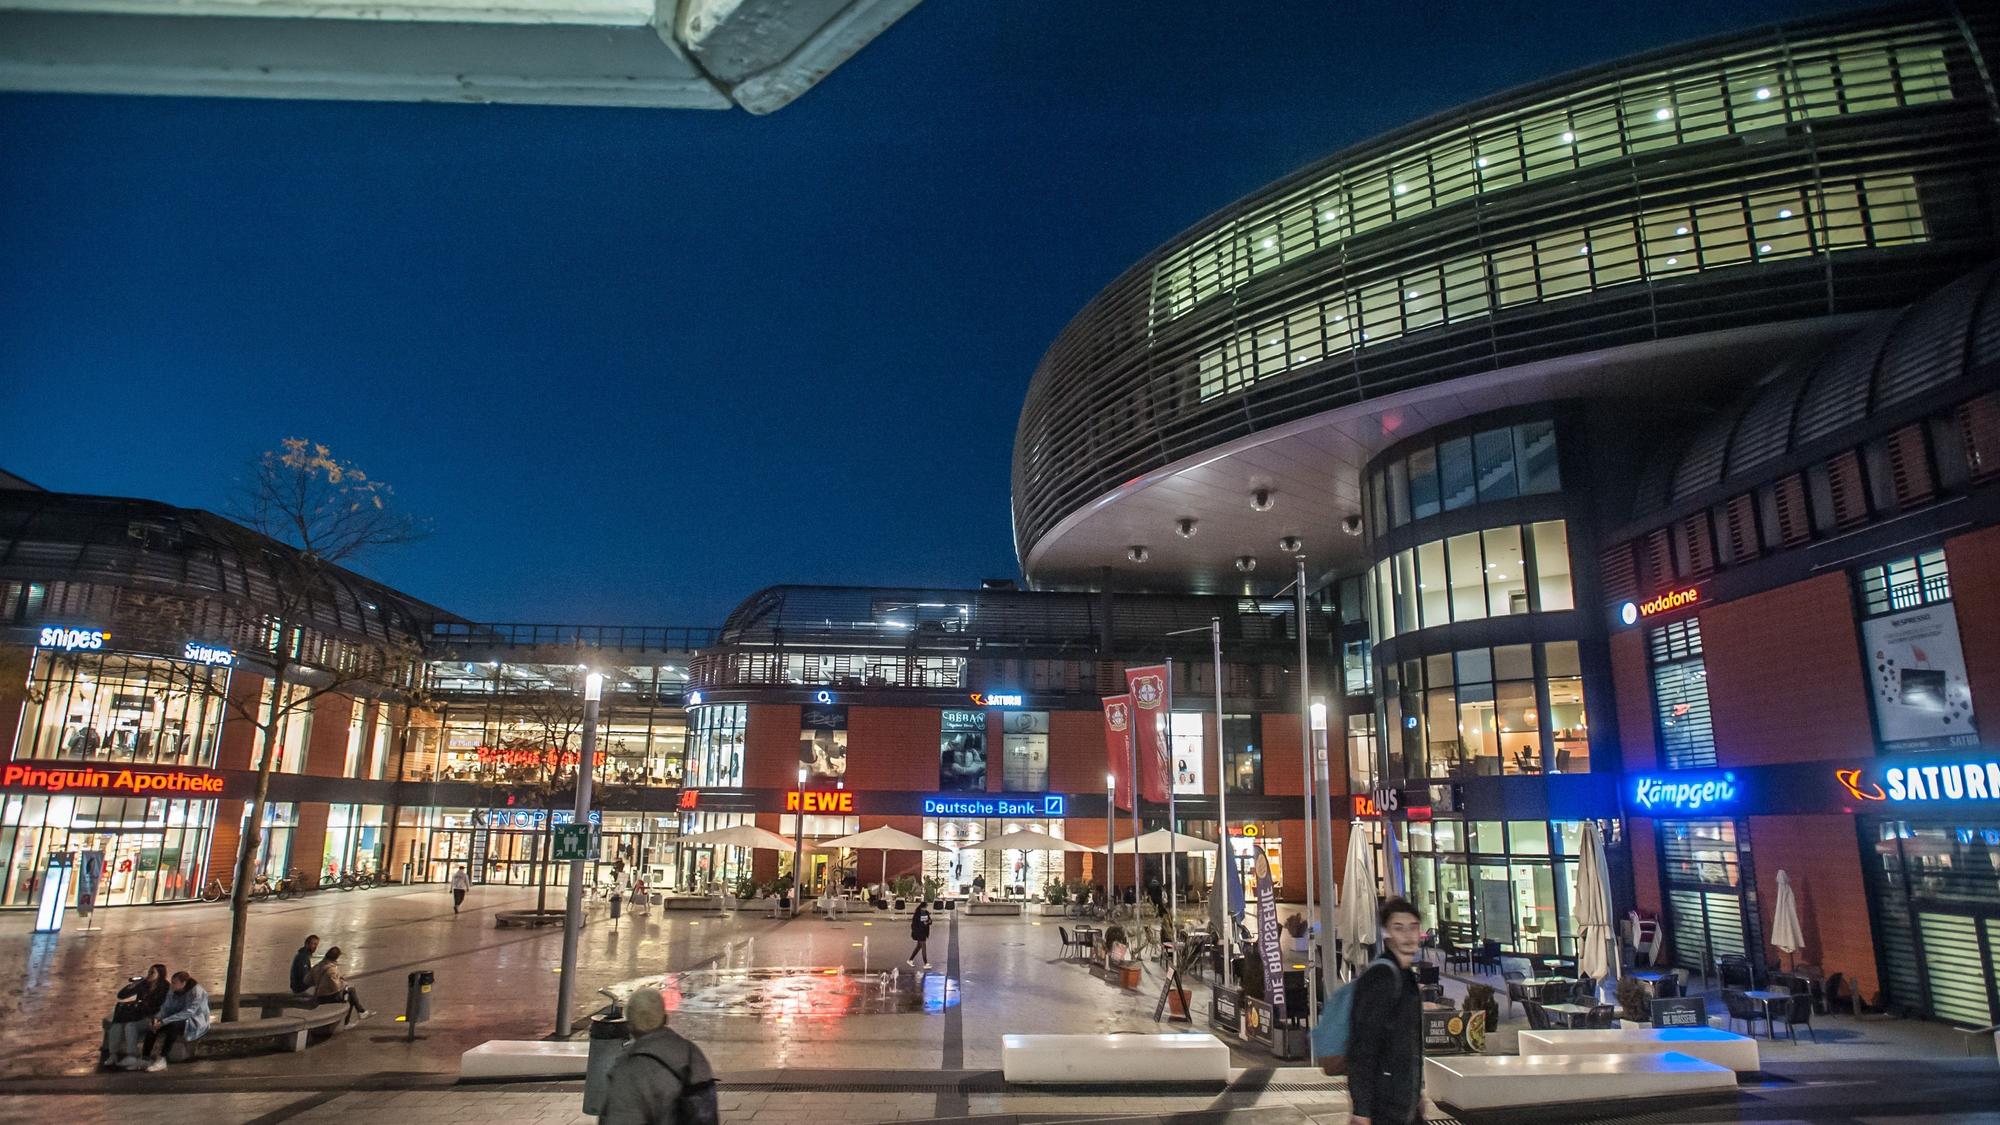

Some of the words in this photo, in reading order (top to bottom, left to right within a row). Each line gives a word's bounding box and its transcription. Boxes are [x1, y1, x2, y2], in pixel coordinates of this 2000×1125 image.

[1640, 588, 1698, 617] vodafone
[4, 766, 109, 791] Pinguin
[113, 770, 224, 793] Apotheke
[1635, 778, 1735, 809] Kämpgen
[1886, 763, 2000, 801] SATURN
[786, 791, 853, 812] REWE
[925, 800, 993, 814] Deutsche
[999, 800, 1035, 814] Bank
